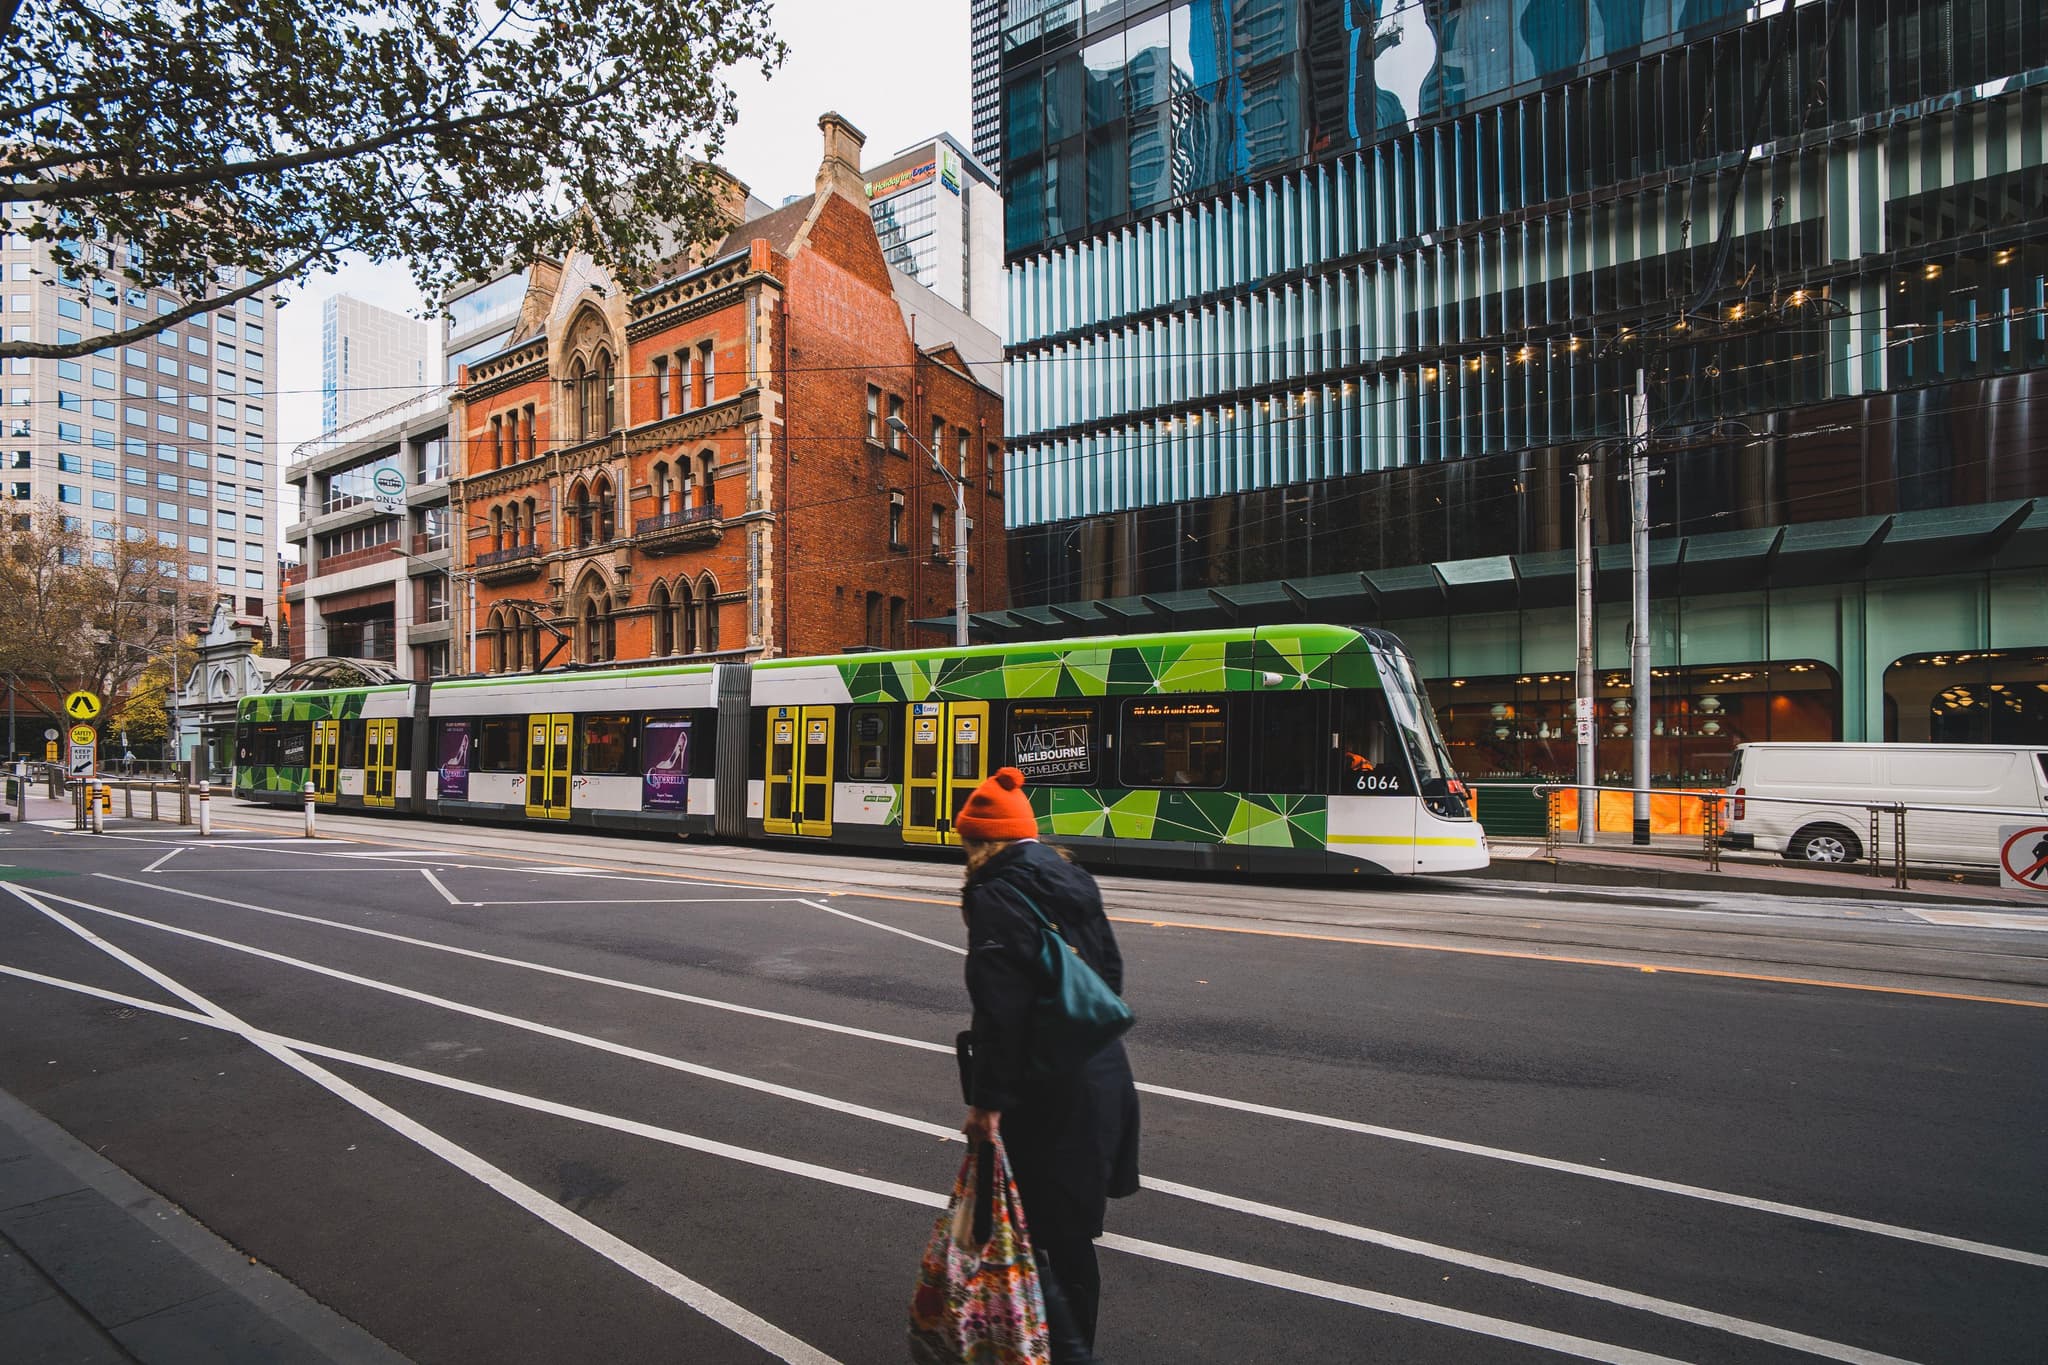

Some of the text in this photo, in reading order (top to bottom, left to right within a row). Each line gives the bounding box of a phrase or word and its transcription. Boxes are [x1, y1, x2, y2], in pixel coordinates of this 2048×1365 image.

[876, 174, 901, 191] Holiday
[912, 162, 936, 177] Express
[376, 496, 403, 505] ONLY
[924, 705, 937, 713] Entry
[1016, 728, 1085, 752] MADE IN
[1018, 746, 1086, 763] MELBOURNE
[1036, 761, 1087, 774] MELBOURNE
[1357, 776, 1399, 790] 6064
